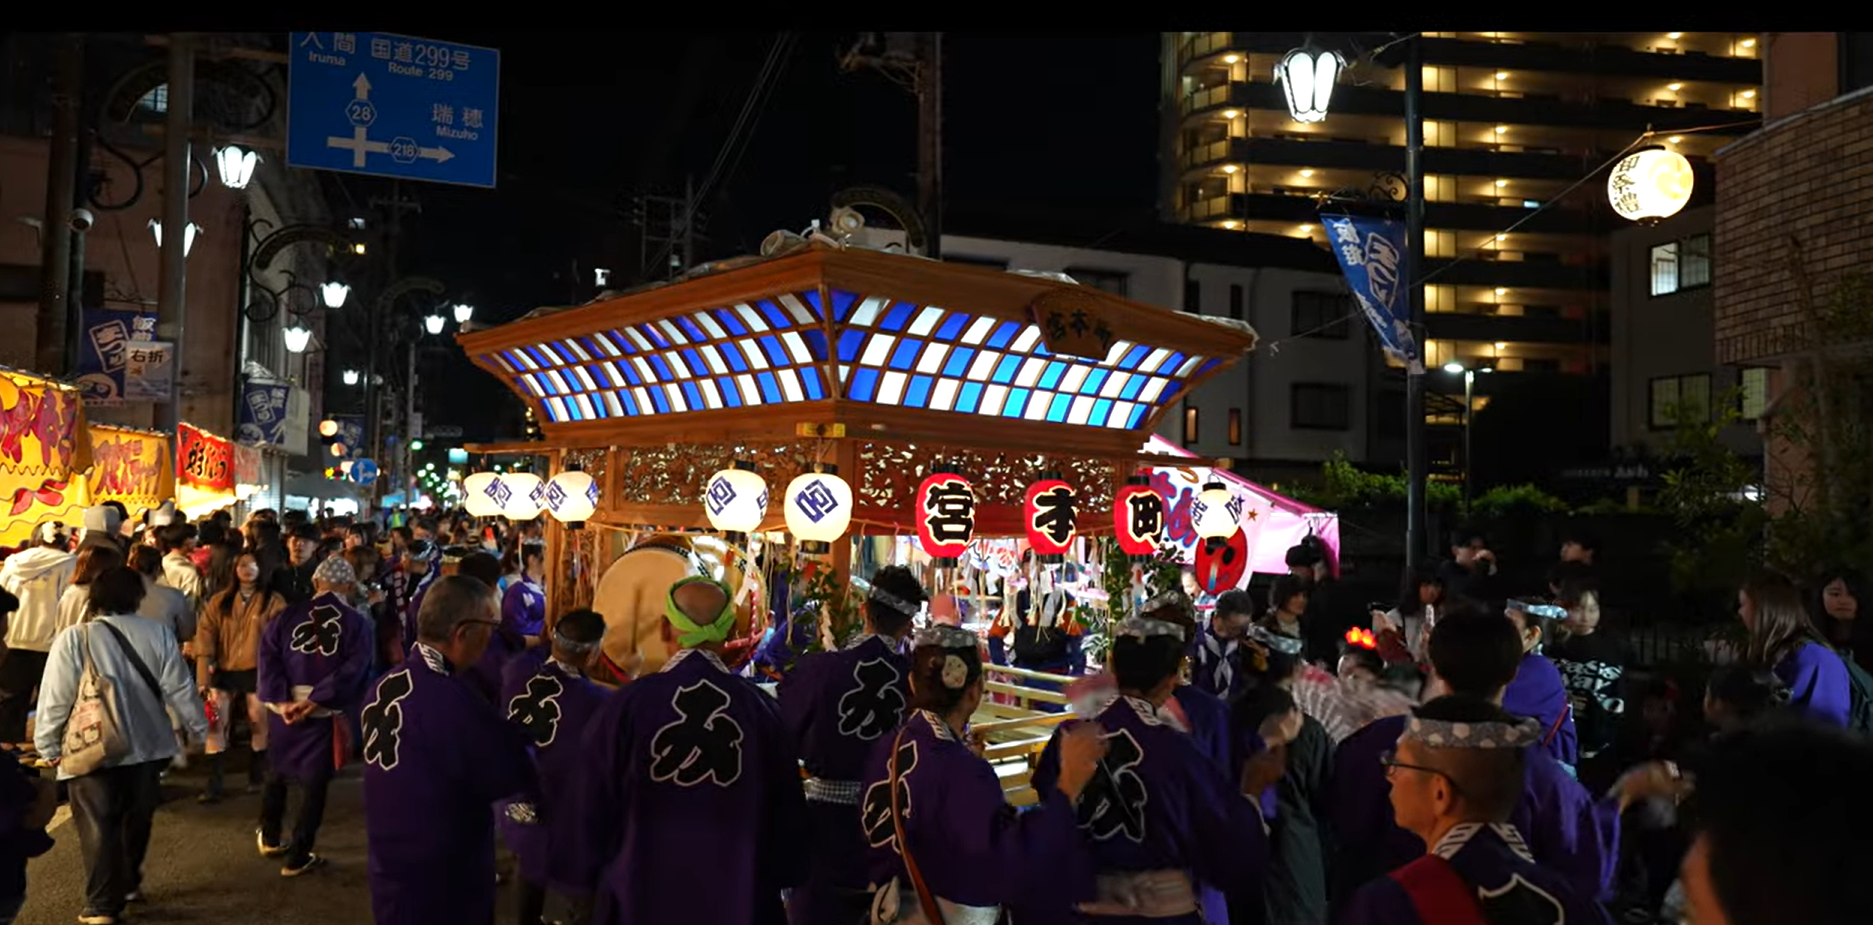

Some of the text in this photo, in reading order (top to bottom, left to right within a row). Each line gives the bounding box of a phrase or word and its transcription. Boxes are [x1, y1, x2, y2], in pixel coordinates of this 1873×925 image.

[308, 51, 346, 67] Iruma
[371, 38, 471, 71] 国道299号
[388, 62, 453, 81] Route 299
[352, 105, 371, 121] 28
[432, 103, 484, 129] 瑞穂
[436, 125, 478, 141] Mizuho
[393, 144, 415, 158] 218
[131, 350, 163, 363] 右折
[923, 479, 975, 546] 宮
[1032, 485, 1077, 547] 本
